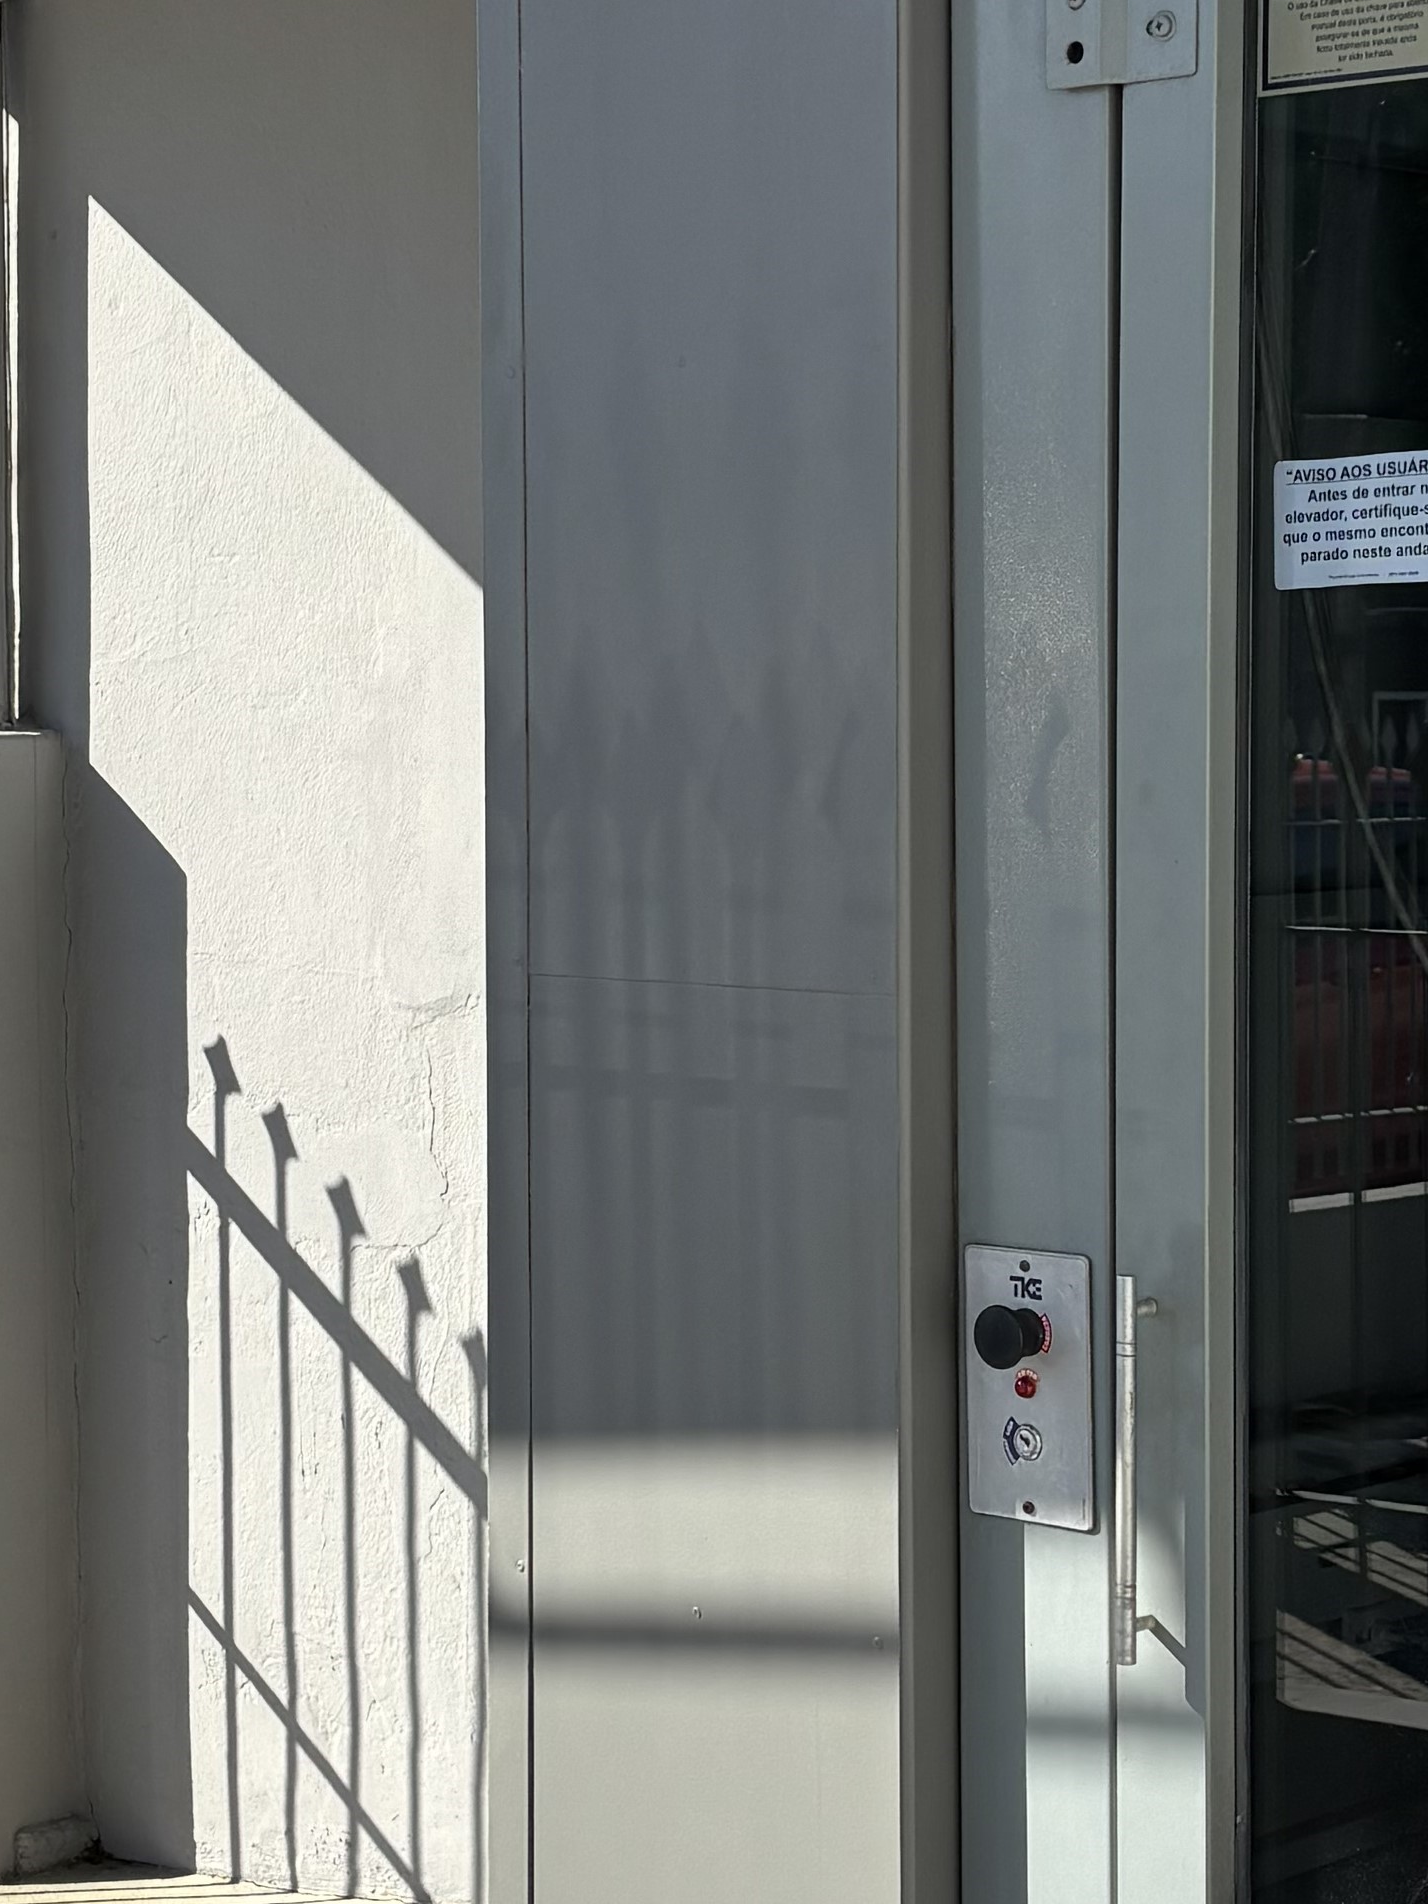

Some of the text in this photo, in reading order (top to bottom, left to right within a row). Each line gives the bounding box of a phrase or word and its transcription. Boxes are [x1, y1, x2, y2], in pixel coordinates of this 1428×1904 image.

[1340, 463, 1372, 479] AOS
[1307, 488, 1348, 503] Antes
[1352, 485, 1369, 500] de
[1373, 482, 1415, 498] entrar
[1285, 508, 1348, 524] elevador,
[1283, 530, 1308, 547] que
[1312, 530, 1321, 543] o
[1325, 527, 1376, 542] mesmo
[1300, 547, 1348, 566] parado
[1353, 544, 1392, 560] neste
[1009, 1274, 1042, 1301] TKE
